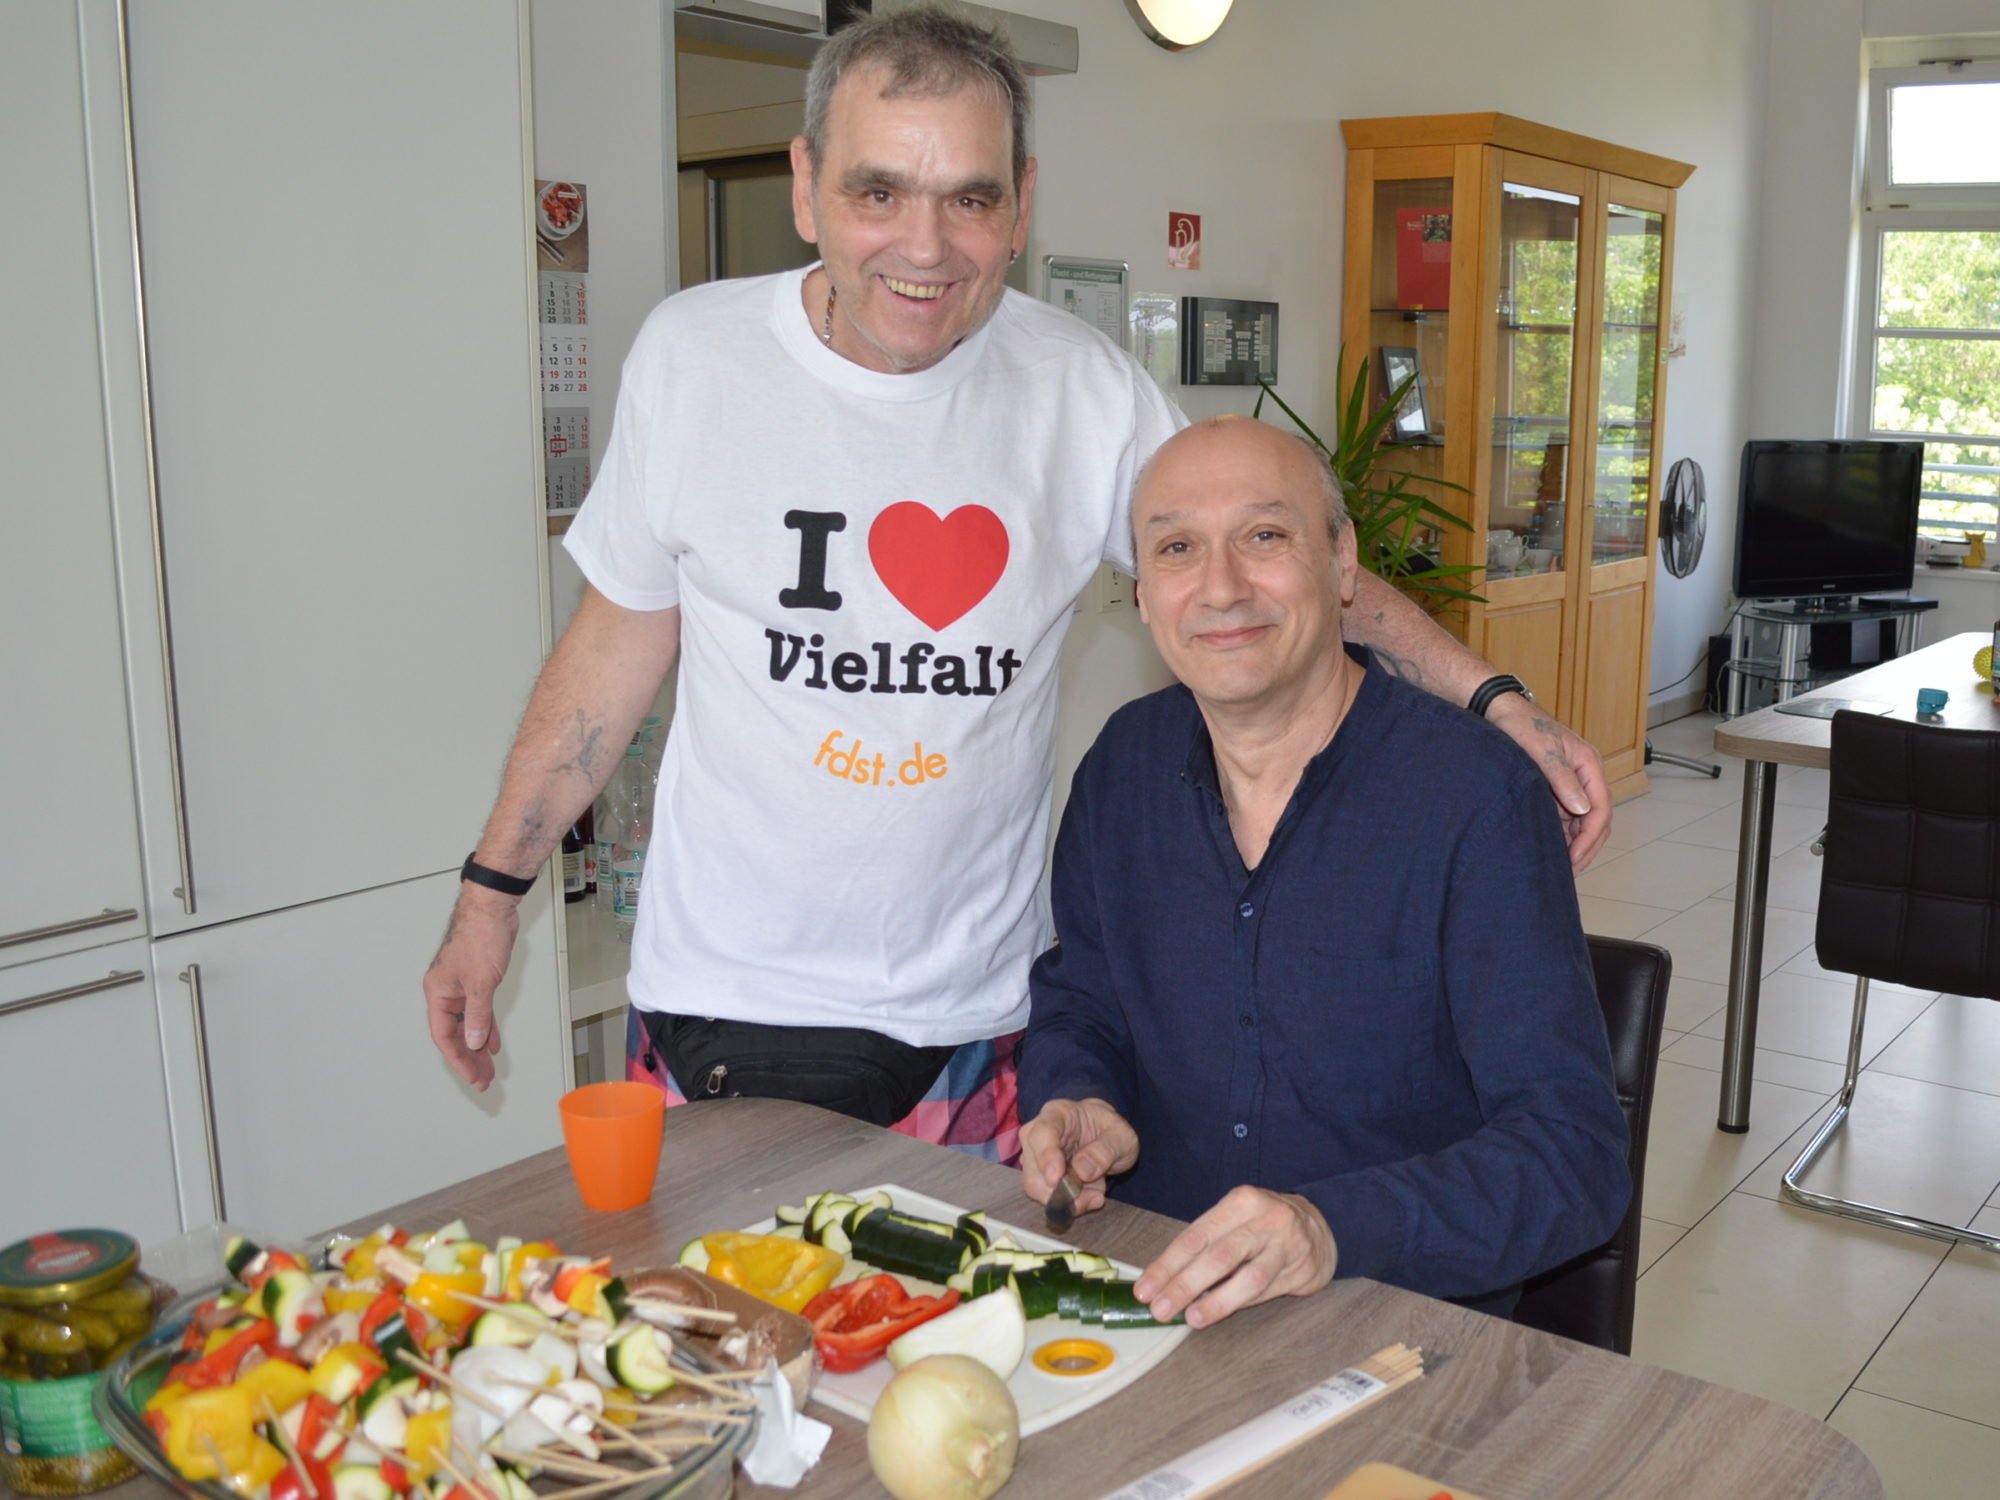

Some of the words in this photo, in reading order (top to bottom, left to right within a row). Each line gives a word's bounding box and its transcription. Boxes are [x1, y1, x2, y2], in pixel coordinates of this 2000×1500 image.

[549, 357, 558, 365] 12
[564, 357, 573, 365] 13
[578, 357, 587, 365] 14
[550, 370, 560, 379] 19
[563, 370, 574, 379] 20
[577, 370, 587, 379] 21
[549, 383, 560, 392] 26
[564, 383, 574, 392] 27
[578, 383, 588, 392] 28
[778, 509, 847, 611] I
[764, 627, 1022, 697] Vielfalt
[811, 730, 949, 788] fdst.de
